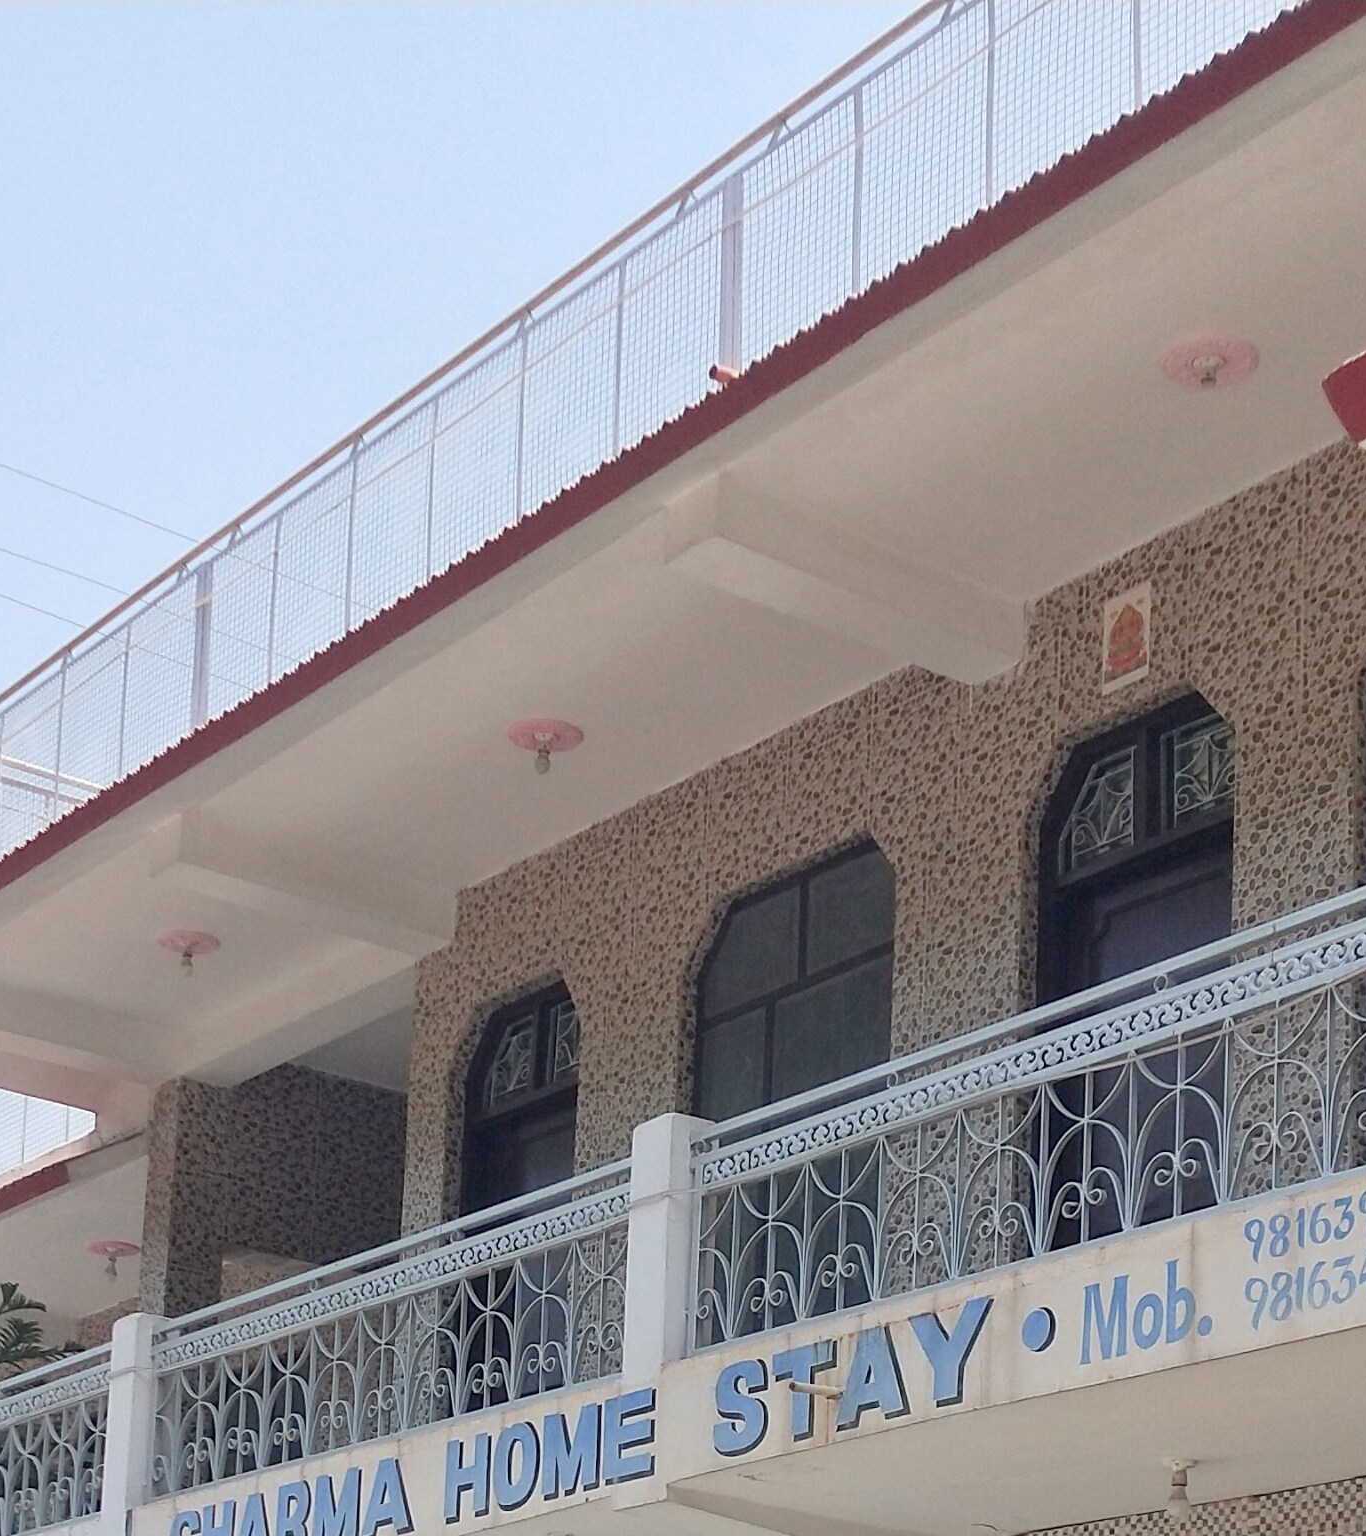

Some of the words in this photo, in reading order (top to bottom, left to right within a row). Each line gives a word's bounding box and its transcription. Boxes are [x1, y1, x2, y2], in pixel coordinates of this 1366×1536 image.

[443, 1387, 656, 1525] HOME
[713, 1295, 995, 1458] STAY
[1079, 1258, 1213, 1365] Mob.
